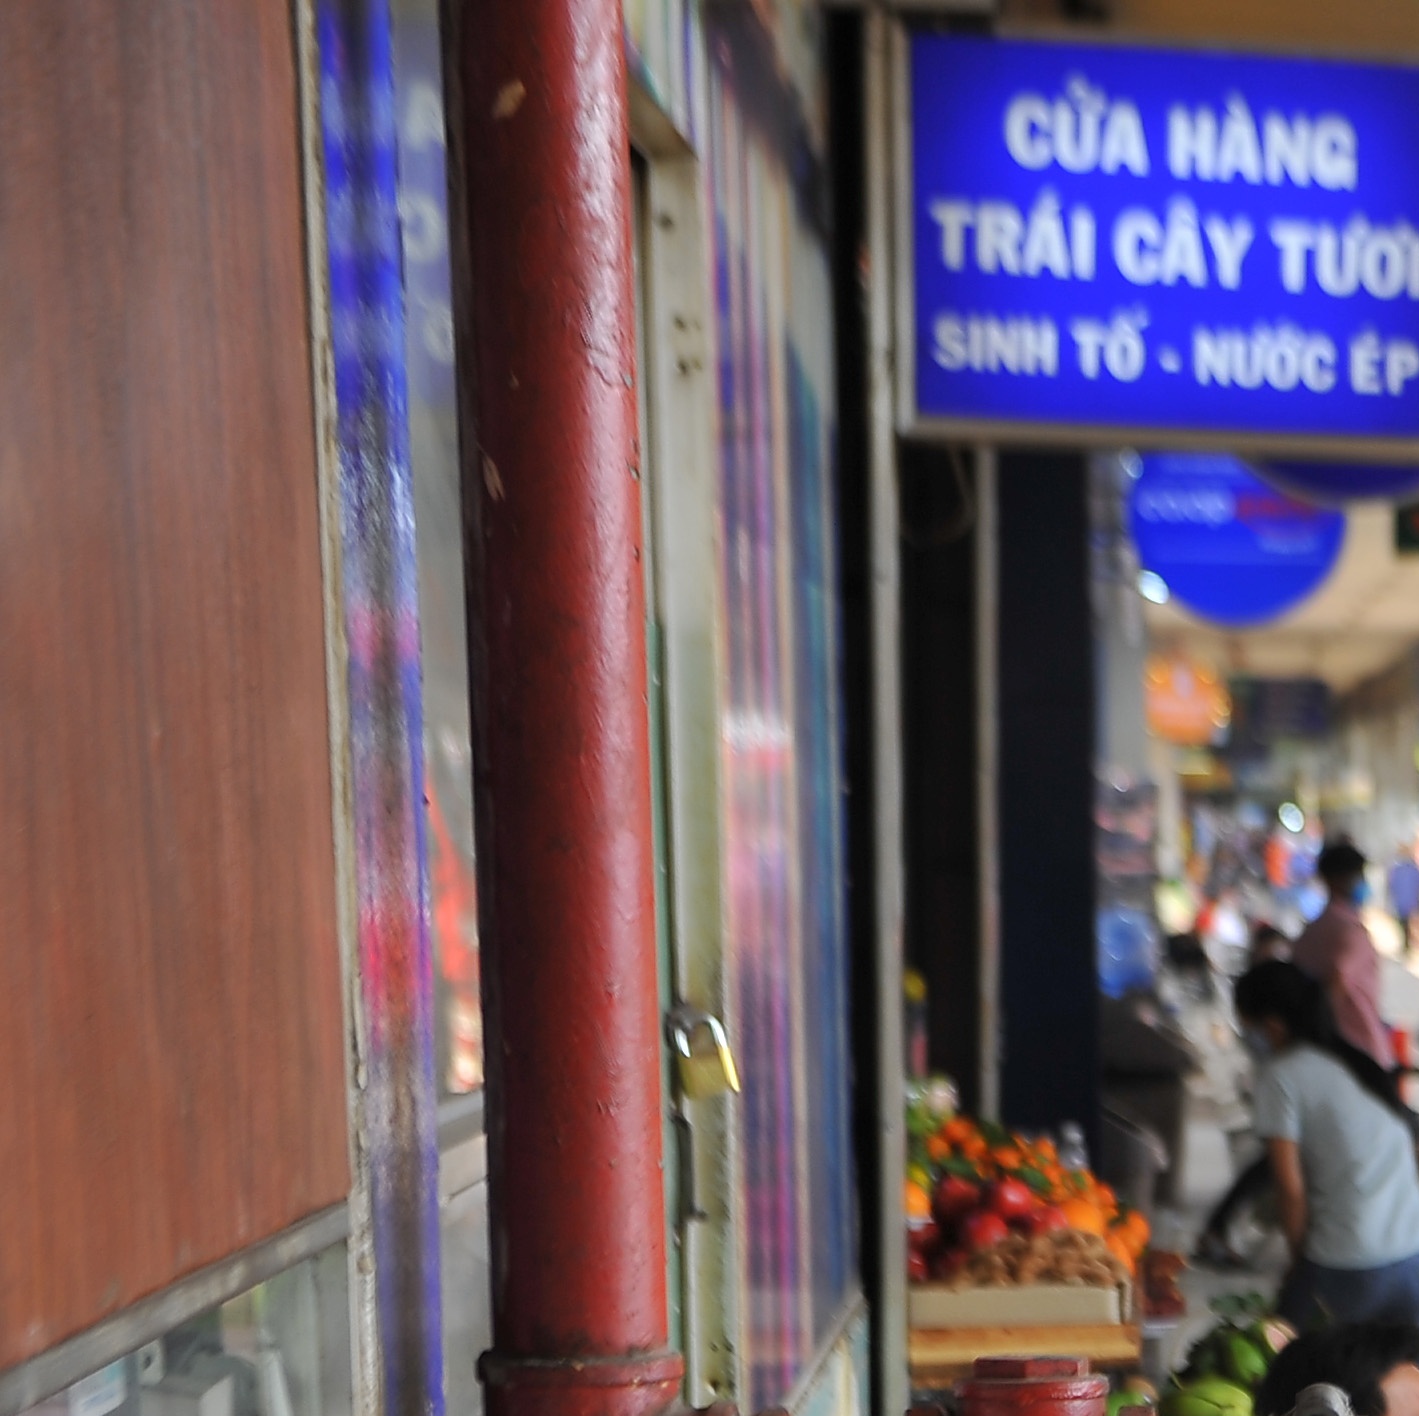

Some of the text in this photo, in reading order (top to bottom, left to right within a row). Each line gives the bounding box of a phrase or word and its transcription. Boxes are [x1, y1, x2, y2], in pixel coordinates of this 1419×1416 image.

[1003, 72, 1358, 191] CỬA HÀNG
[929, 188, 1097, 282] TRÁI
[1113, 199, 1253, 291] CÂY
[931, 313, 1058, 378] SINH
[1193, 318, 1338, 396] NƯỚC
